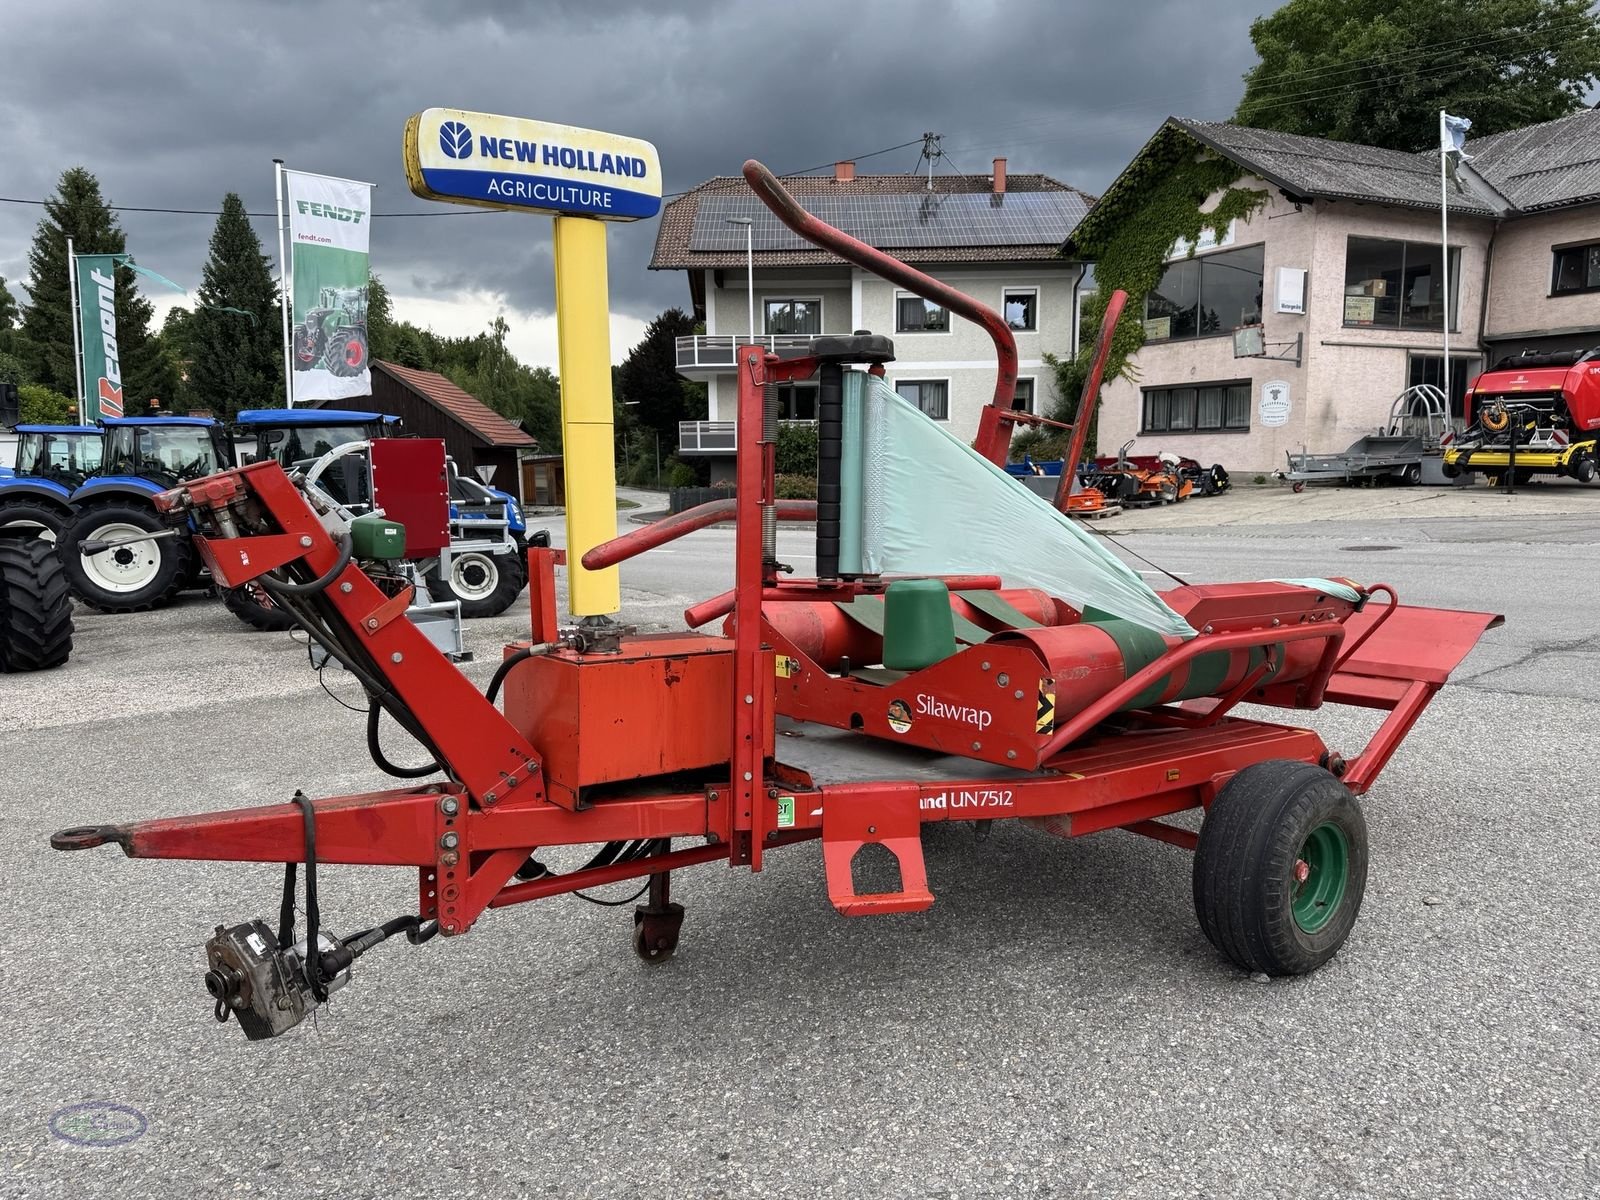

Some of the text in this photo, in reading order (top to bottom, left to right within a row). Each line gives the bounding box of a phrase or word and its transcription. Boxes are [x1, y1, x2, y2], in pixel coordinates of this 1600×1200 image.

[480, 135, 646, 178] NEW HOLLAND
[487, 178, 612, 208] AGRICULTURE
[296, 200, 366, 224] FENDT
[298, 233, 332, 243] fendt.com
[917, 693, 992, 731] Silawrap
[950, 790, 1014, 808] UN7512
